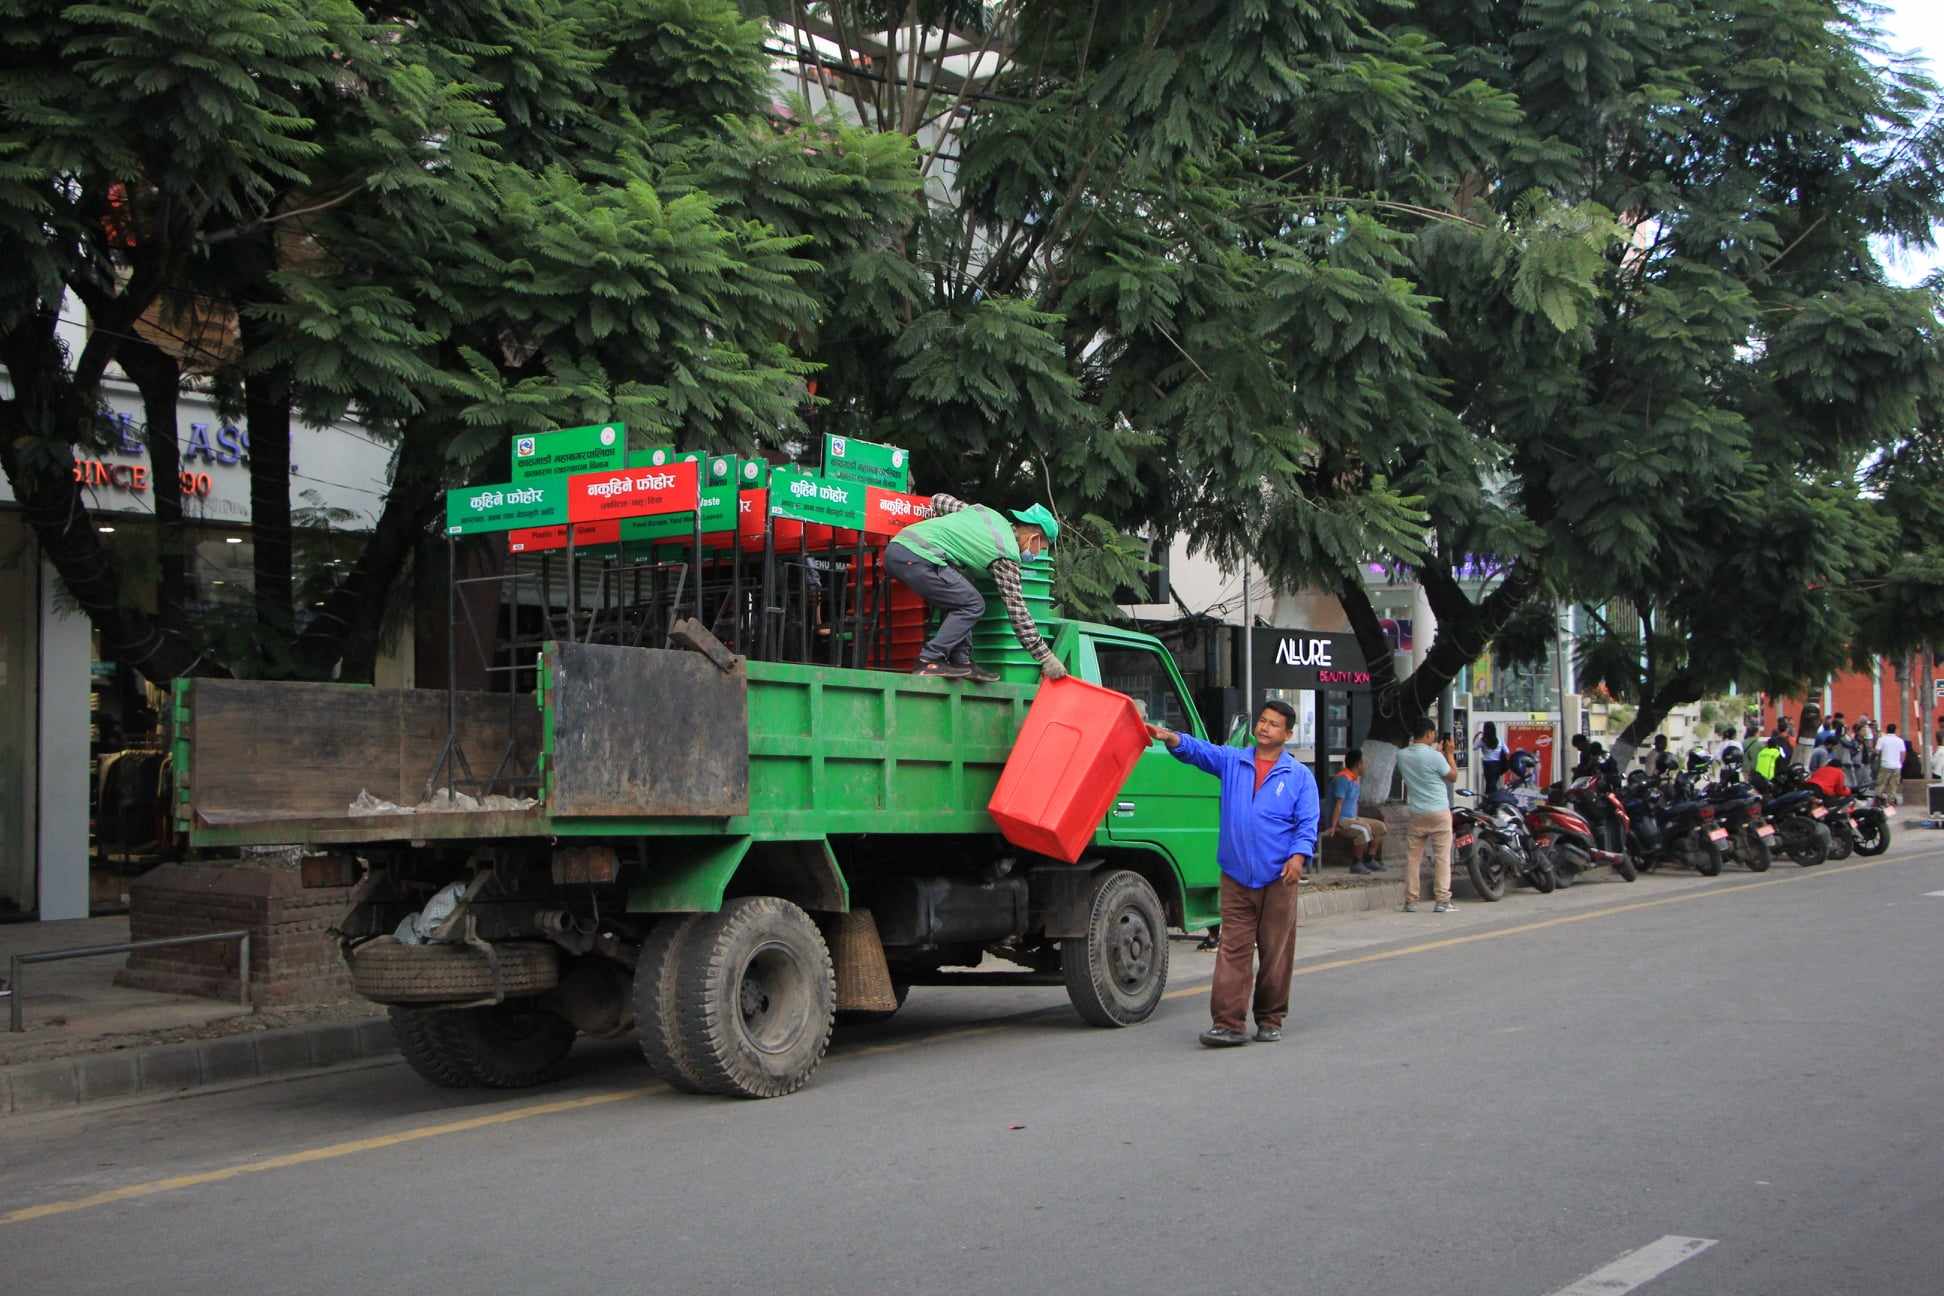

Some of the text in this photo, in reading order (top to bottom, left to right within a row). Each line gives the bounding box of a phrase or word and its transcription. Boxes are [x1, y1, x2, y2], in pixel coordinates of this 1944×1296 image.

[587, 472, 676, 498] नकुहिने फोहोर
[790, 480, 817, 499] कुहिने
[820, 485, 849, 504] फोहोर
[470, 487, 544, 512] कुहिने फोहोर
[1275, 638, 1332, 667] ALLURE
[1319, 671, 1347, 683] BEAUTY
